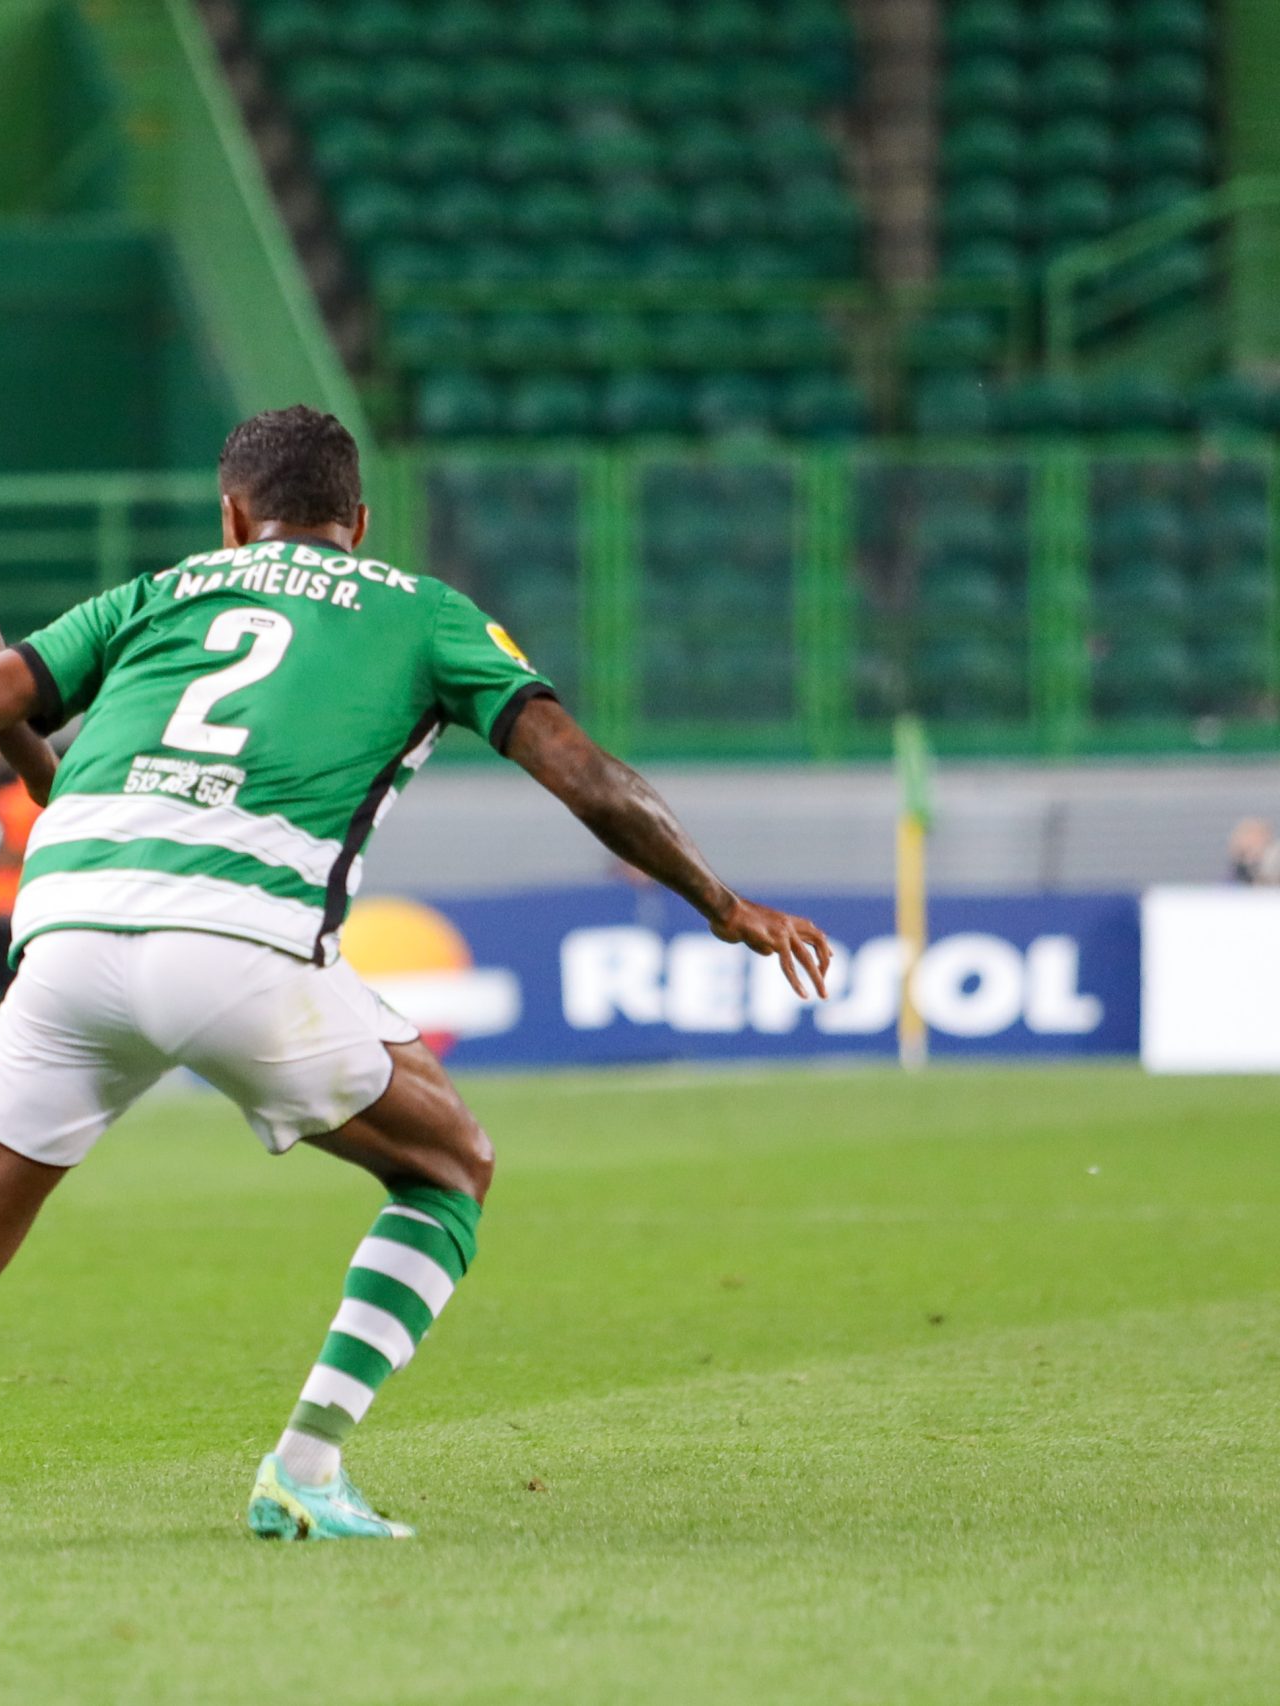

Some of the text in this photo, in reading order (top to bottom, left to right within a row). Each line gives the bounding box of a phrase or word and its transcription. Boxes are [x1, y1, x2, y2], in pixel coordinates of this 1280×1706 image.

[174, 562, 362, 611] MATHEUS R.
[292, 545, 418, 594] BOCK
[161, 607, 293, 756] 2
[123, 769, 161, 793] 513
[195, 775, 239, 806] 554
[561, 925, 1104, 1037] REPSOL
